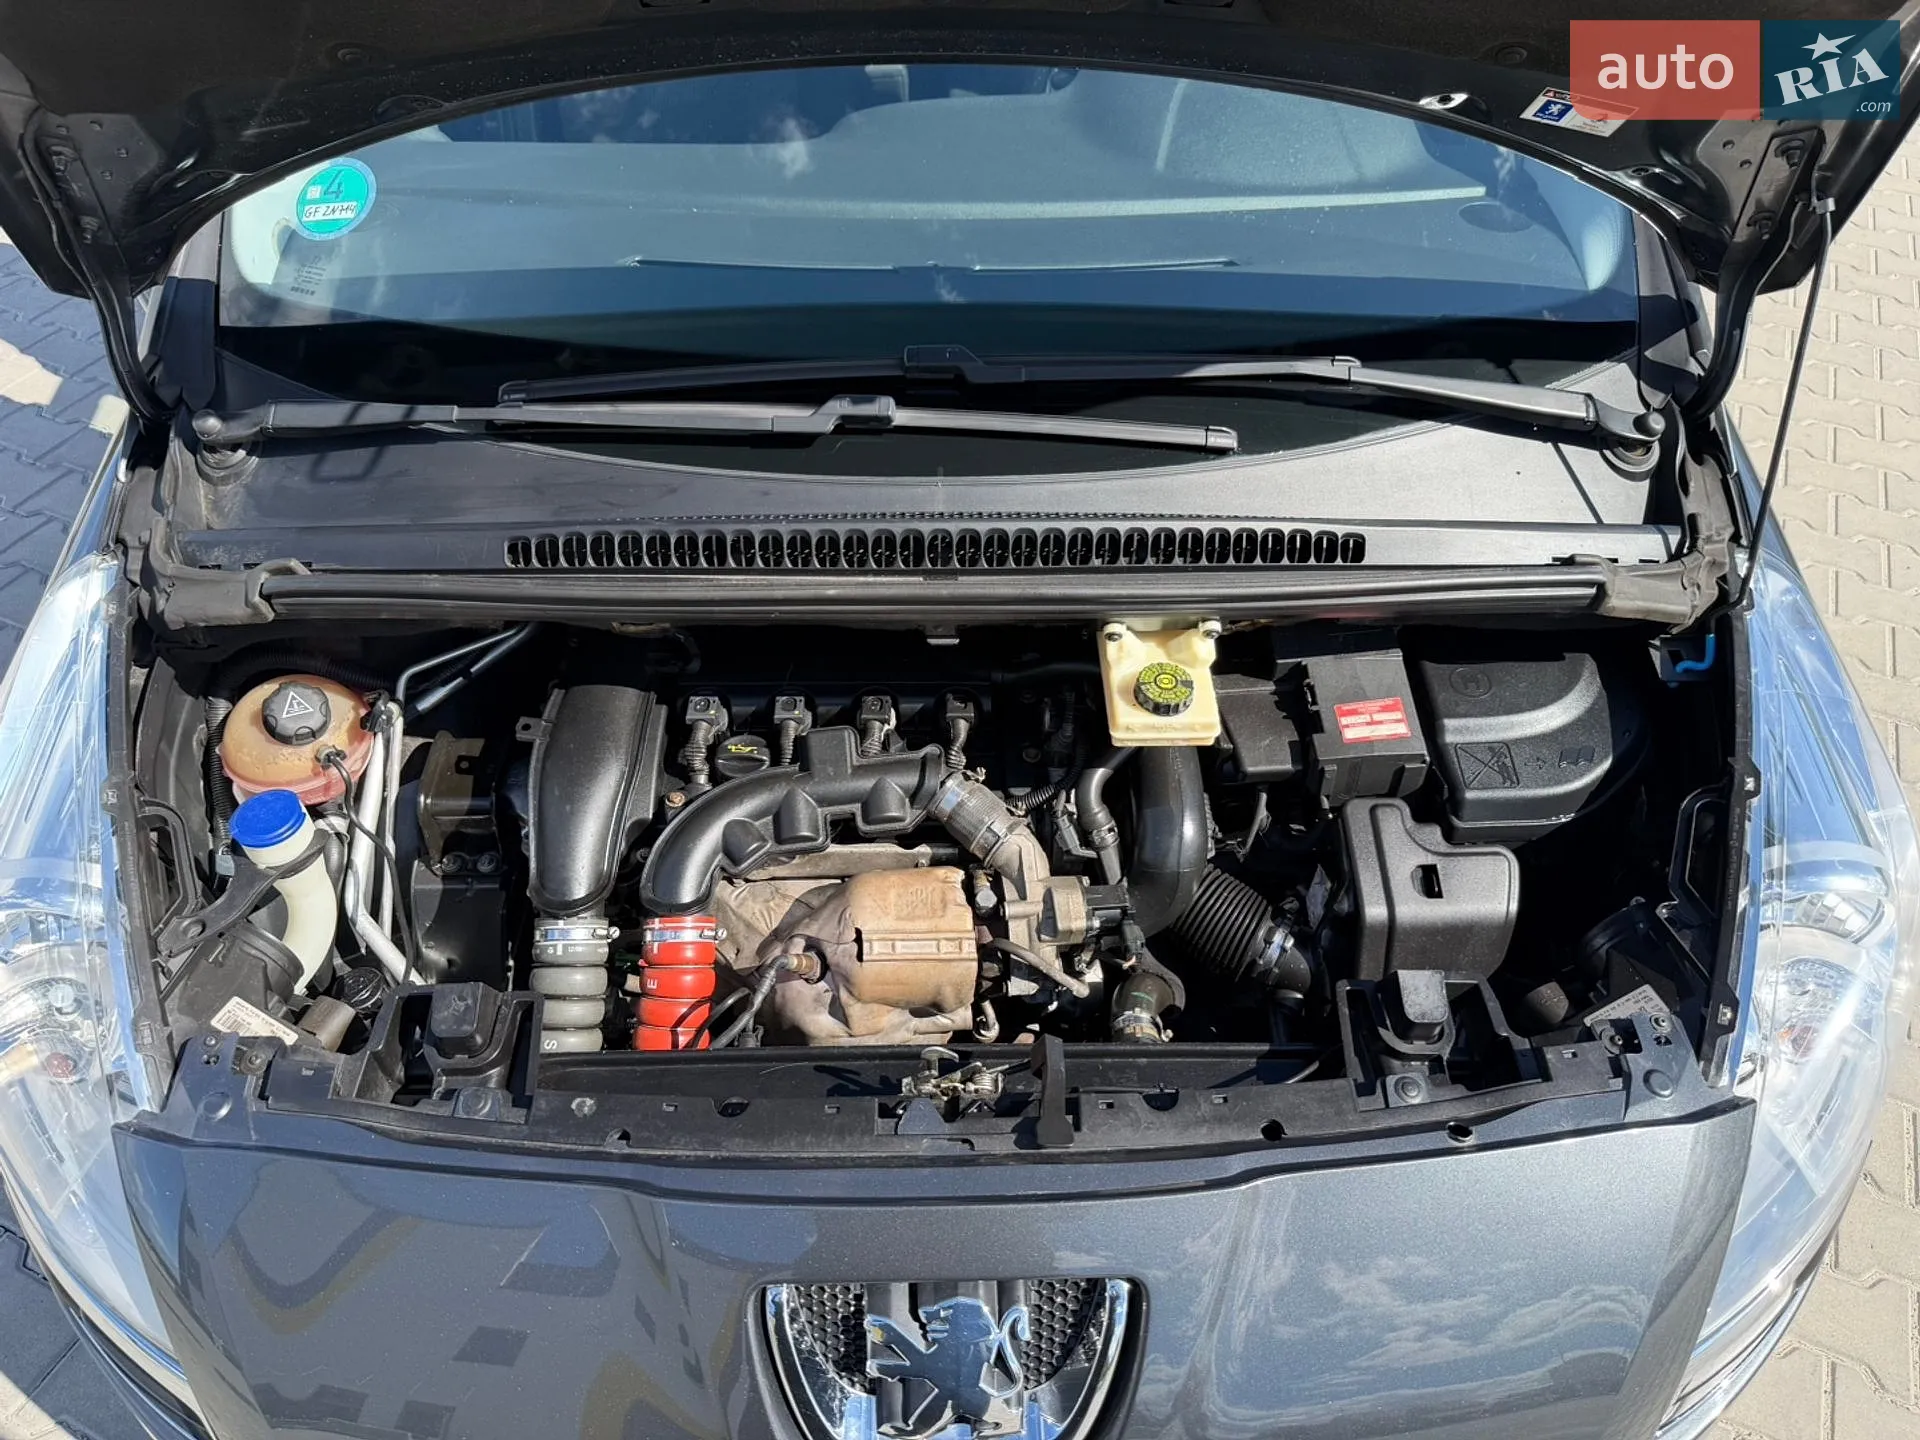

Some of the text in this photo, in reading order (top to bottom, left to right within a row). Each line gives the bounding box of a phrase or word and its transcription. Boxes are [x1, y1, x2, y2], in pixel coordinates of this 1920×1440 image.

[323, 168, 344, 200] 4
[647, 978, 658, 989] E
[544, 1039, 558, 1050] S
